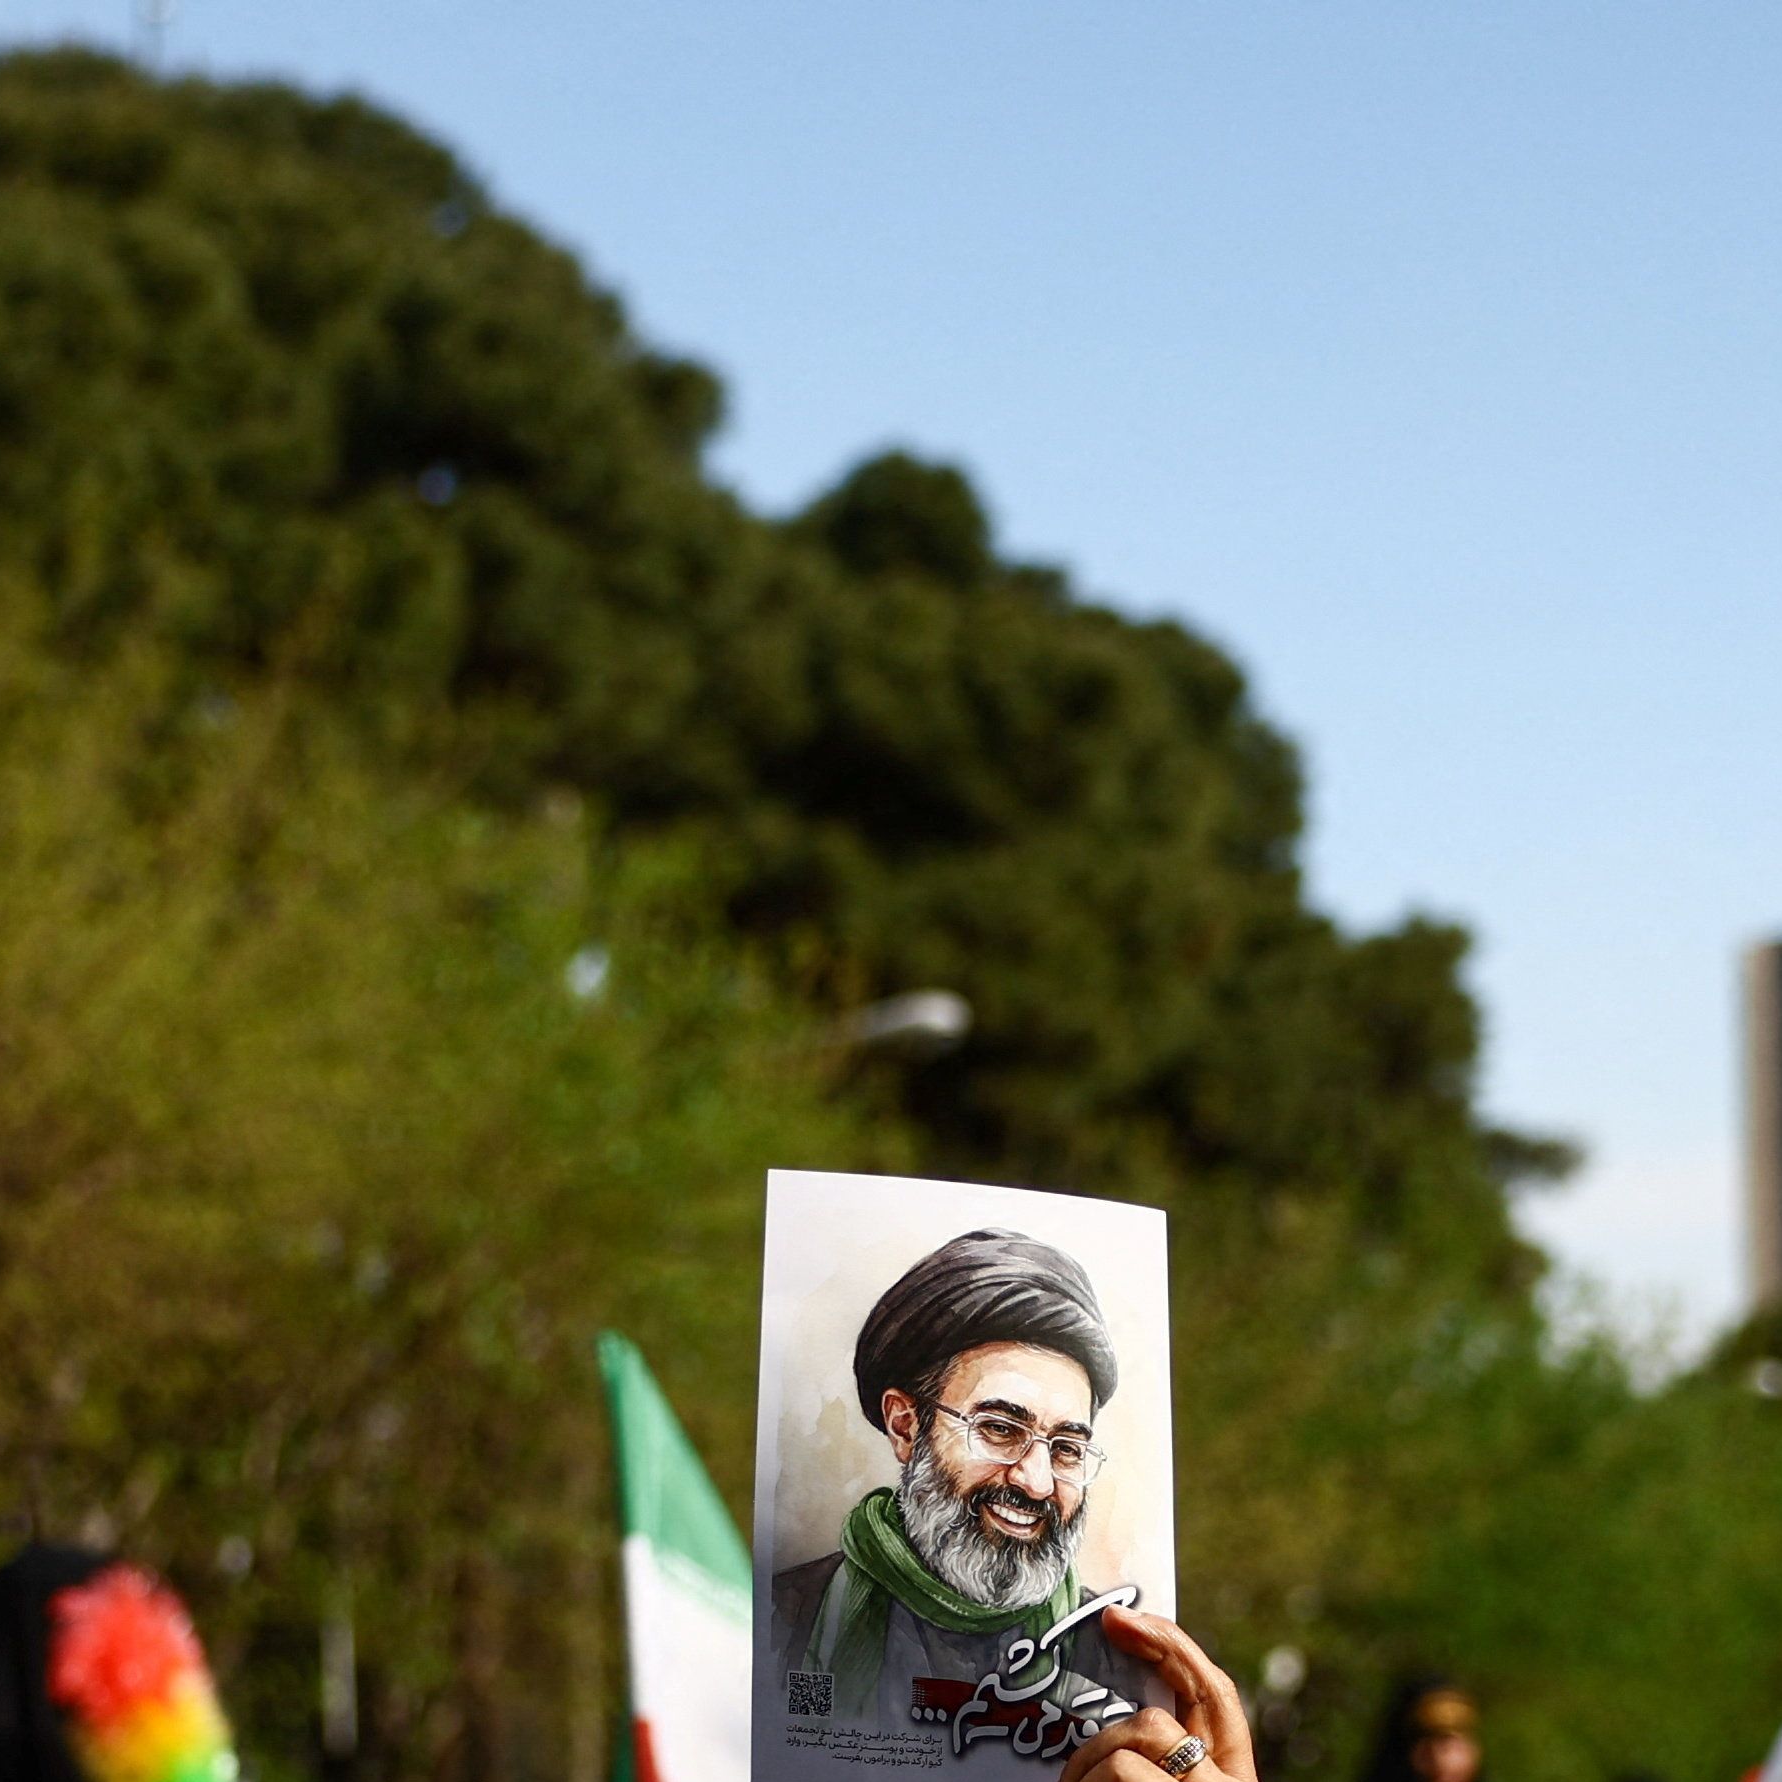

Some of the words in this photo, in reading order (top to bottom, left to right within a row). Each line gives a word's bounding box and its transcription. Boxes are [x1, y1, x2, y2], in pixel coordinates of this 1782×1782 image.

[785, 1724, 820, 1736] تجمعات
[833, 1728, 862, 1741] چالش
[785, 1736, 801, 1747] وارد
[863, 1730, 882, 1742] این
[881, 1732, 891, 1742] در
[891, 1732, 921, 1743] شرکت
[922, 1734, 943, 1745] برای
[829, 1740, 859, 1750] عکس
[859, 1744, 899, 1755] پوستر
[906, 1745, 937, 1756] خودت
[863, 1754, 891, 1766] برامون
